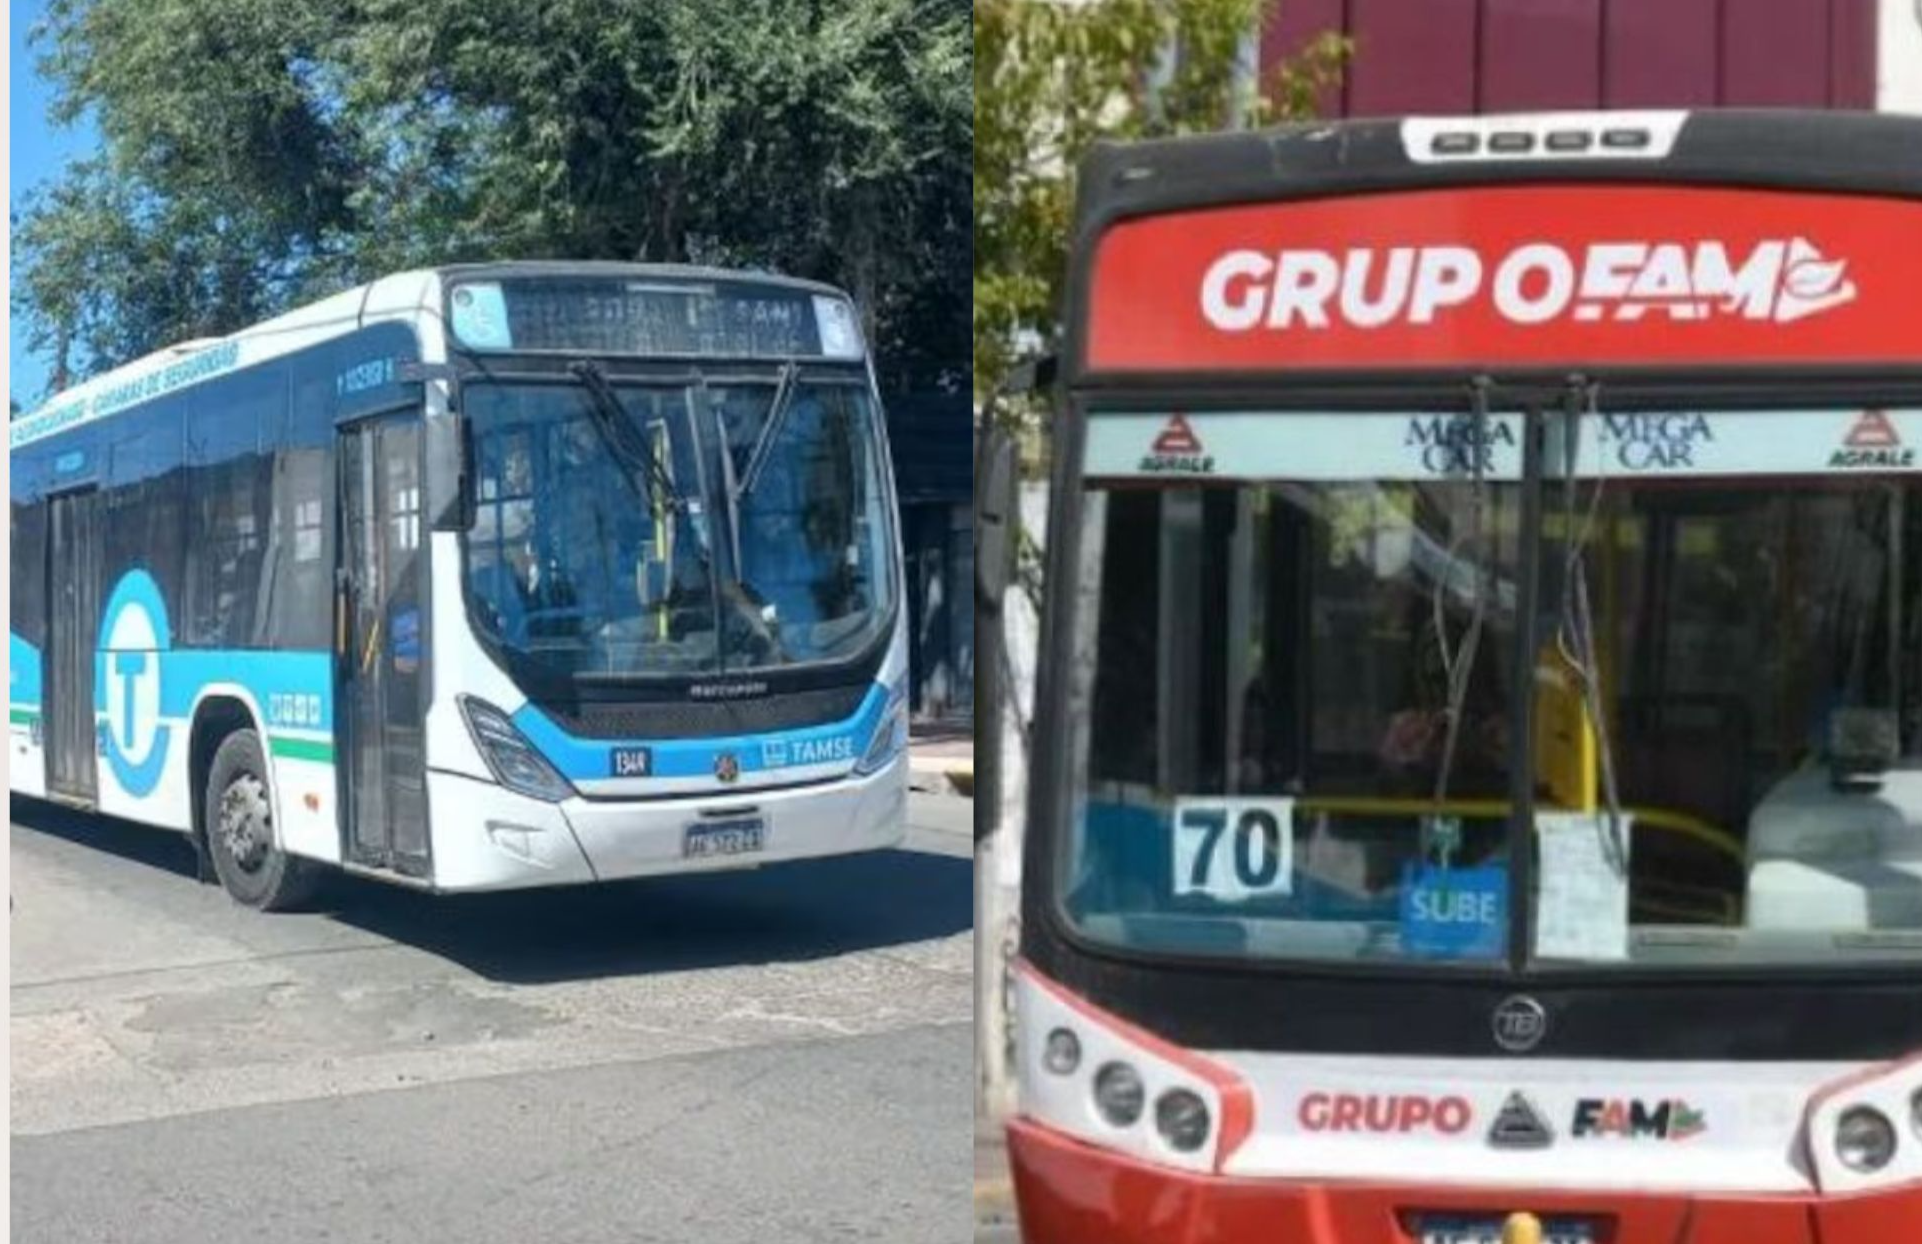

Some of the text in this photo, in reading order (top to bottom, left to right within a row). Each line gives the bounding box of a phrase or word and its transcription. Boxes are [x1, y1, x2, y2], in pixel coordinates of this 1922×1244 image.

[1404, 416, 1515, 446] MEGA
[1600, 413, 1713, 441] MEGA
[1137, 456, 1215, 473] AGRALE
[1422, 444, 1496, 473] CAR
[1617, 440, 1694, 470] CAR
[1828, 449, 1914, 468] AGRALE
[792, 736, 853, 763] TAMSE
[1181, 809, 1280, 888] 70
[1409, 889, 1497, 923] SUBE
[1298, 1092, 1472, 1133] GRUPO
[1571, 1099, 1671, 1139] FAM
